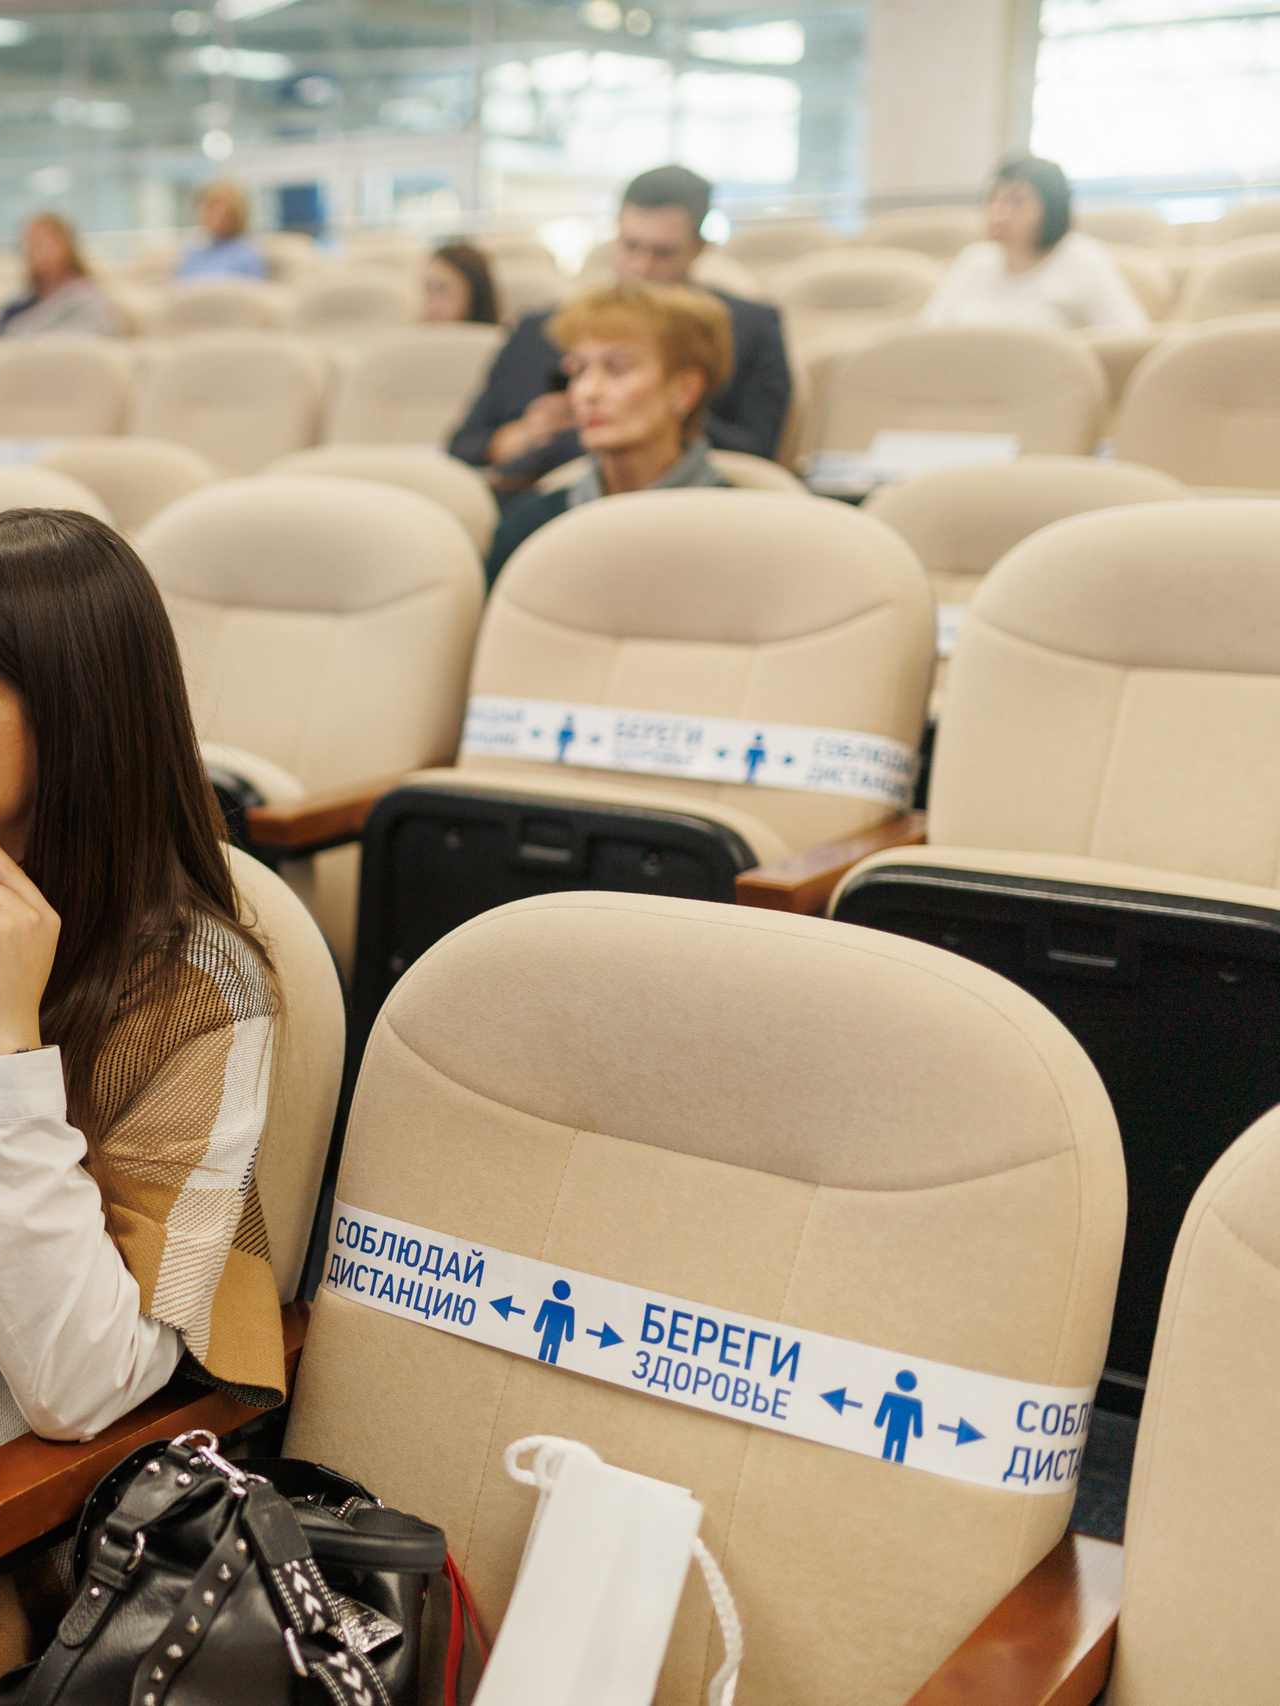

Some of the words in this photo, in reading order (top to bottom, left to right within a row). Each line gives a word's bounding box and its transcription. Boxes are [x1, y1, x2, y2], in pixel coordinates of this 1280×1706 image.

[335, 1216, 485, 1288] СОБЛЮДАЙ
[326, 1253, 477, 1326] ДИСТАНЦИЮ
[640, 1302, 801, 1383] БЕРЕГИ
[631, 1350, 792, 1420] ЗДОРОВЬЕ
